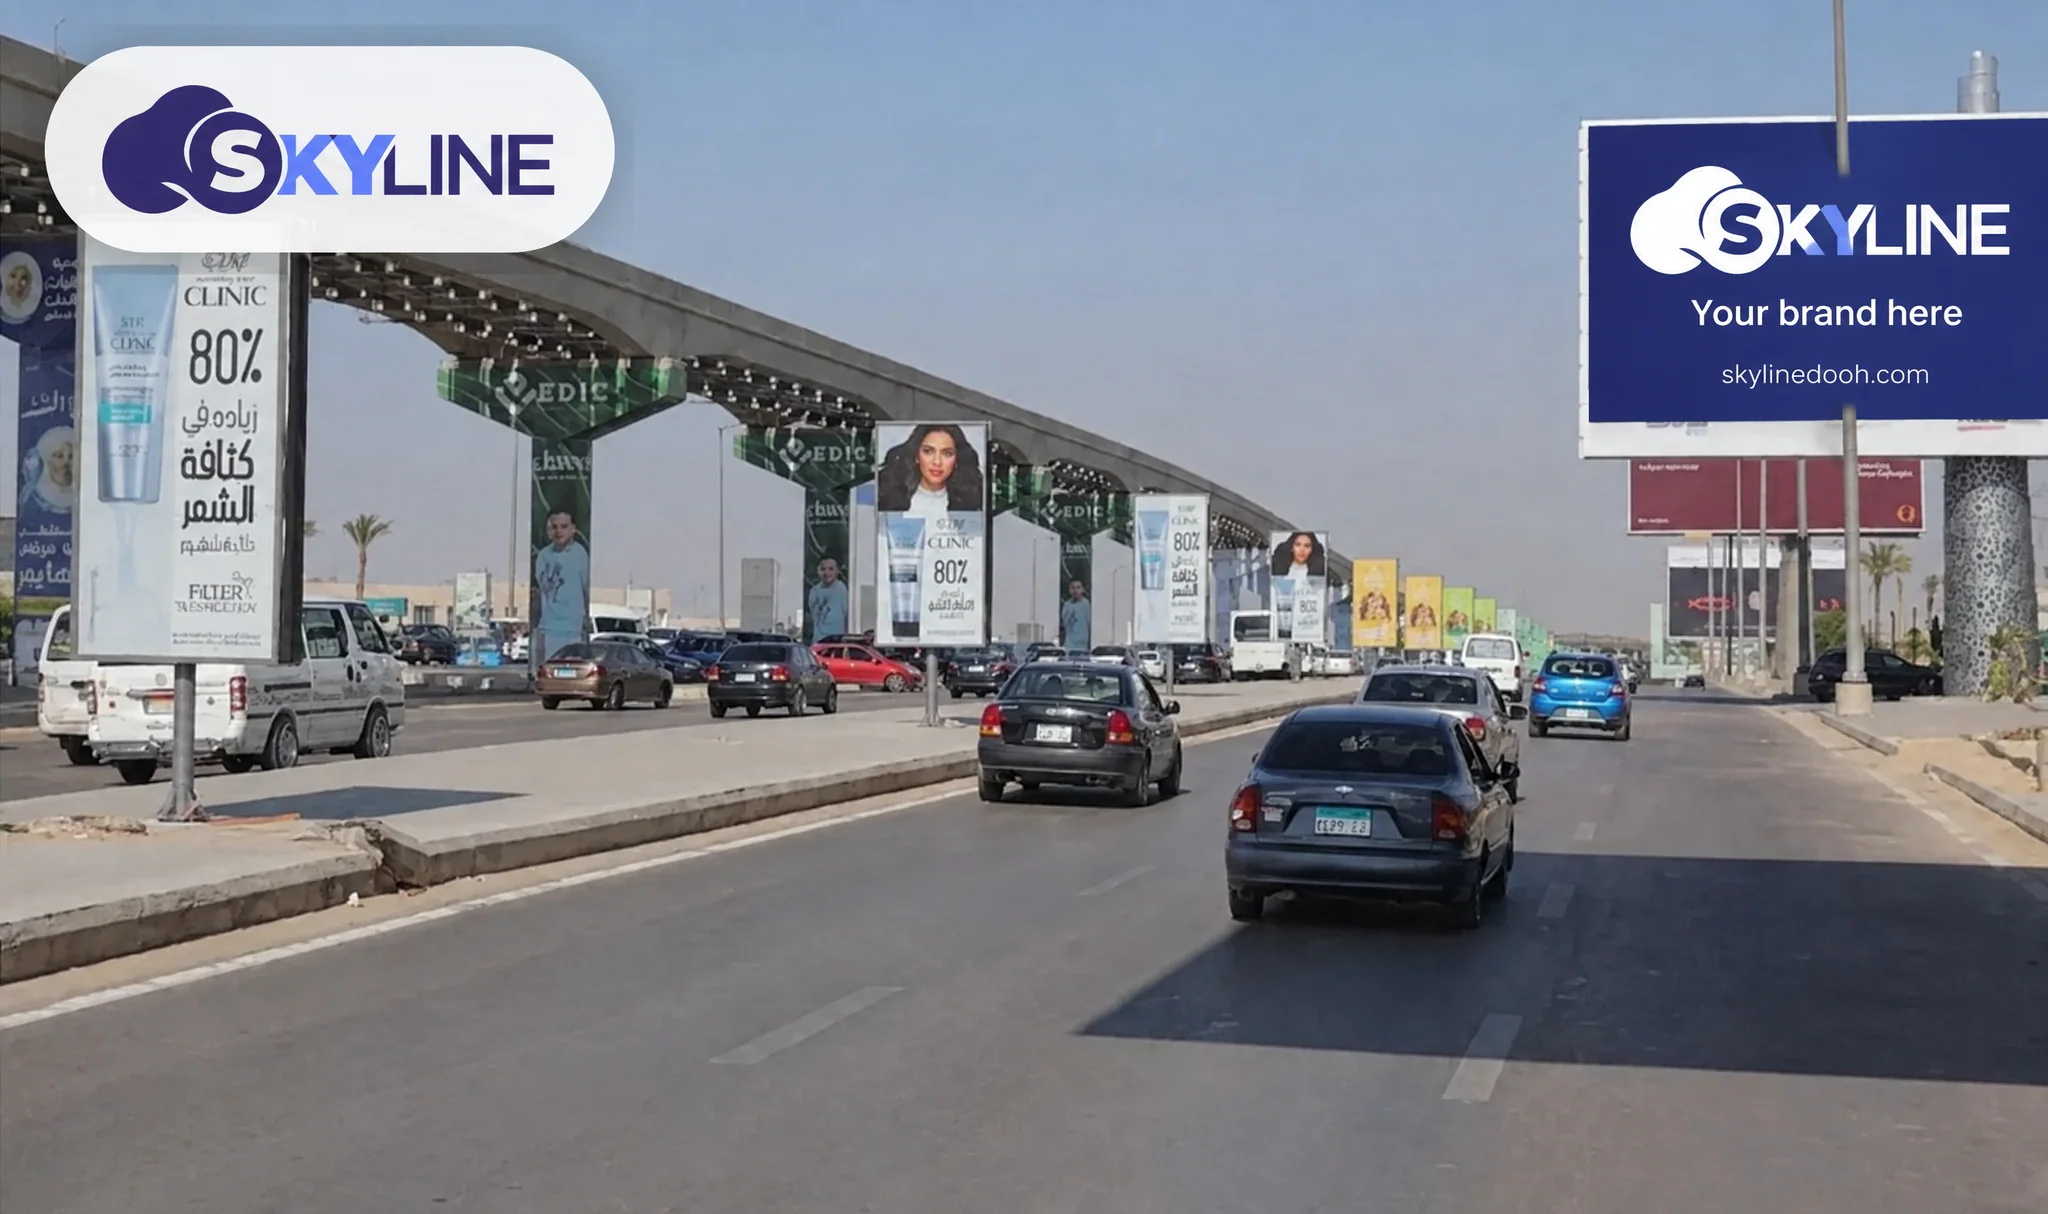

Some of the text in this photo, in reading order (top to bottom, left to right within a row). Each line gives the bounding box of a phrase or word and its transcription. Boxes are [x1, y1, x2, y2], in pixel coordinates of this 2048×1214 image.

[1718, 203, 2010, 255] SKYLINE
[184, 286, 267, 306] CLINIC
[1691, 299, 1963, 326] Your brand here
[190, 328, 263, 385] 80%
[1722, 364, 1929, 389] skylinedooh.com
[181, 438, 255, 481] كثافة
[928, 537, 974, 549] CLINIC
[1174, 532, 1200, 551] 80%
[934, 559, 968, 584] 80%
